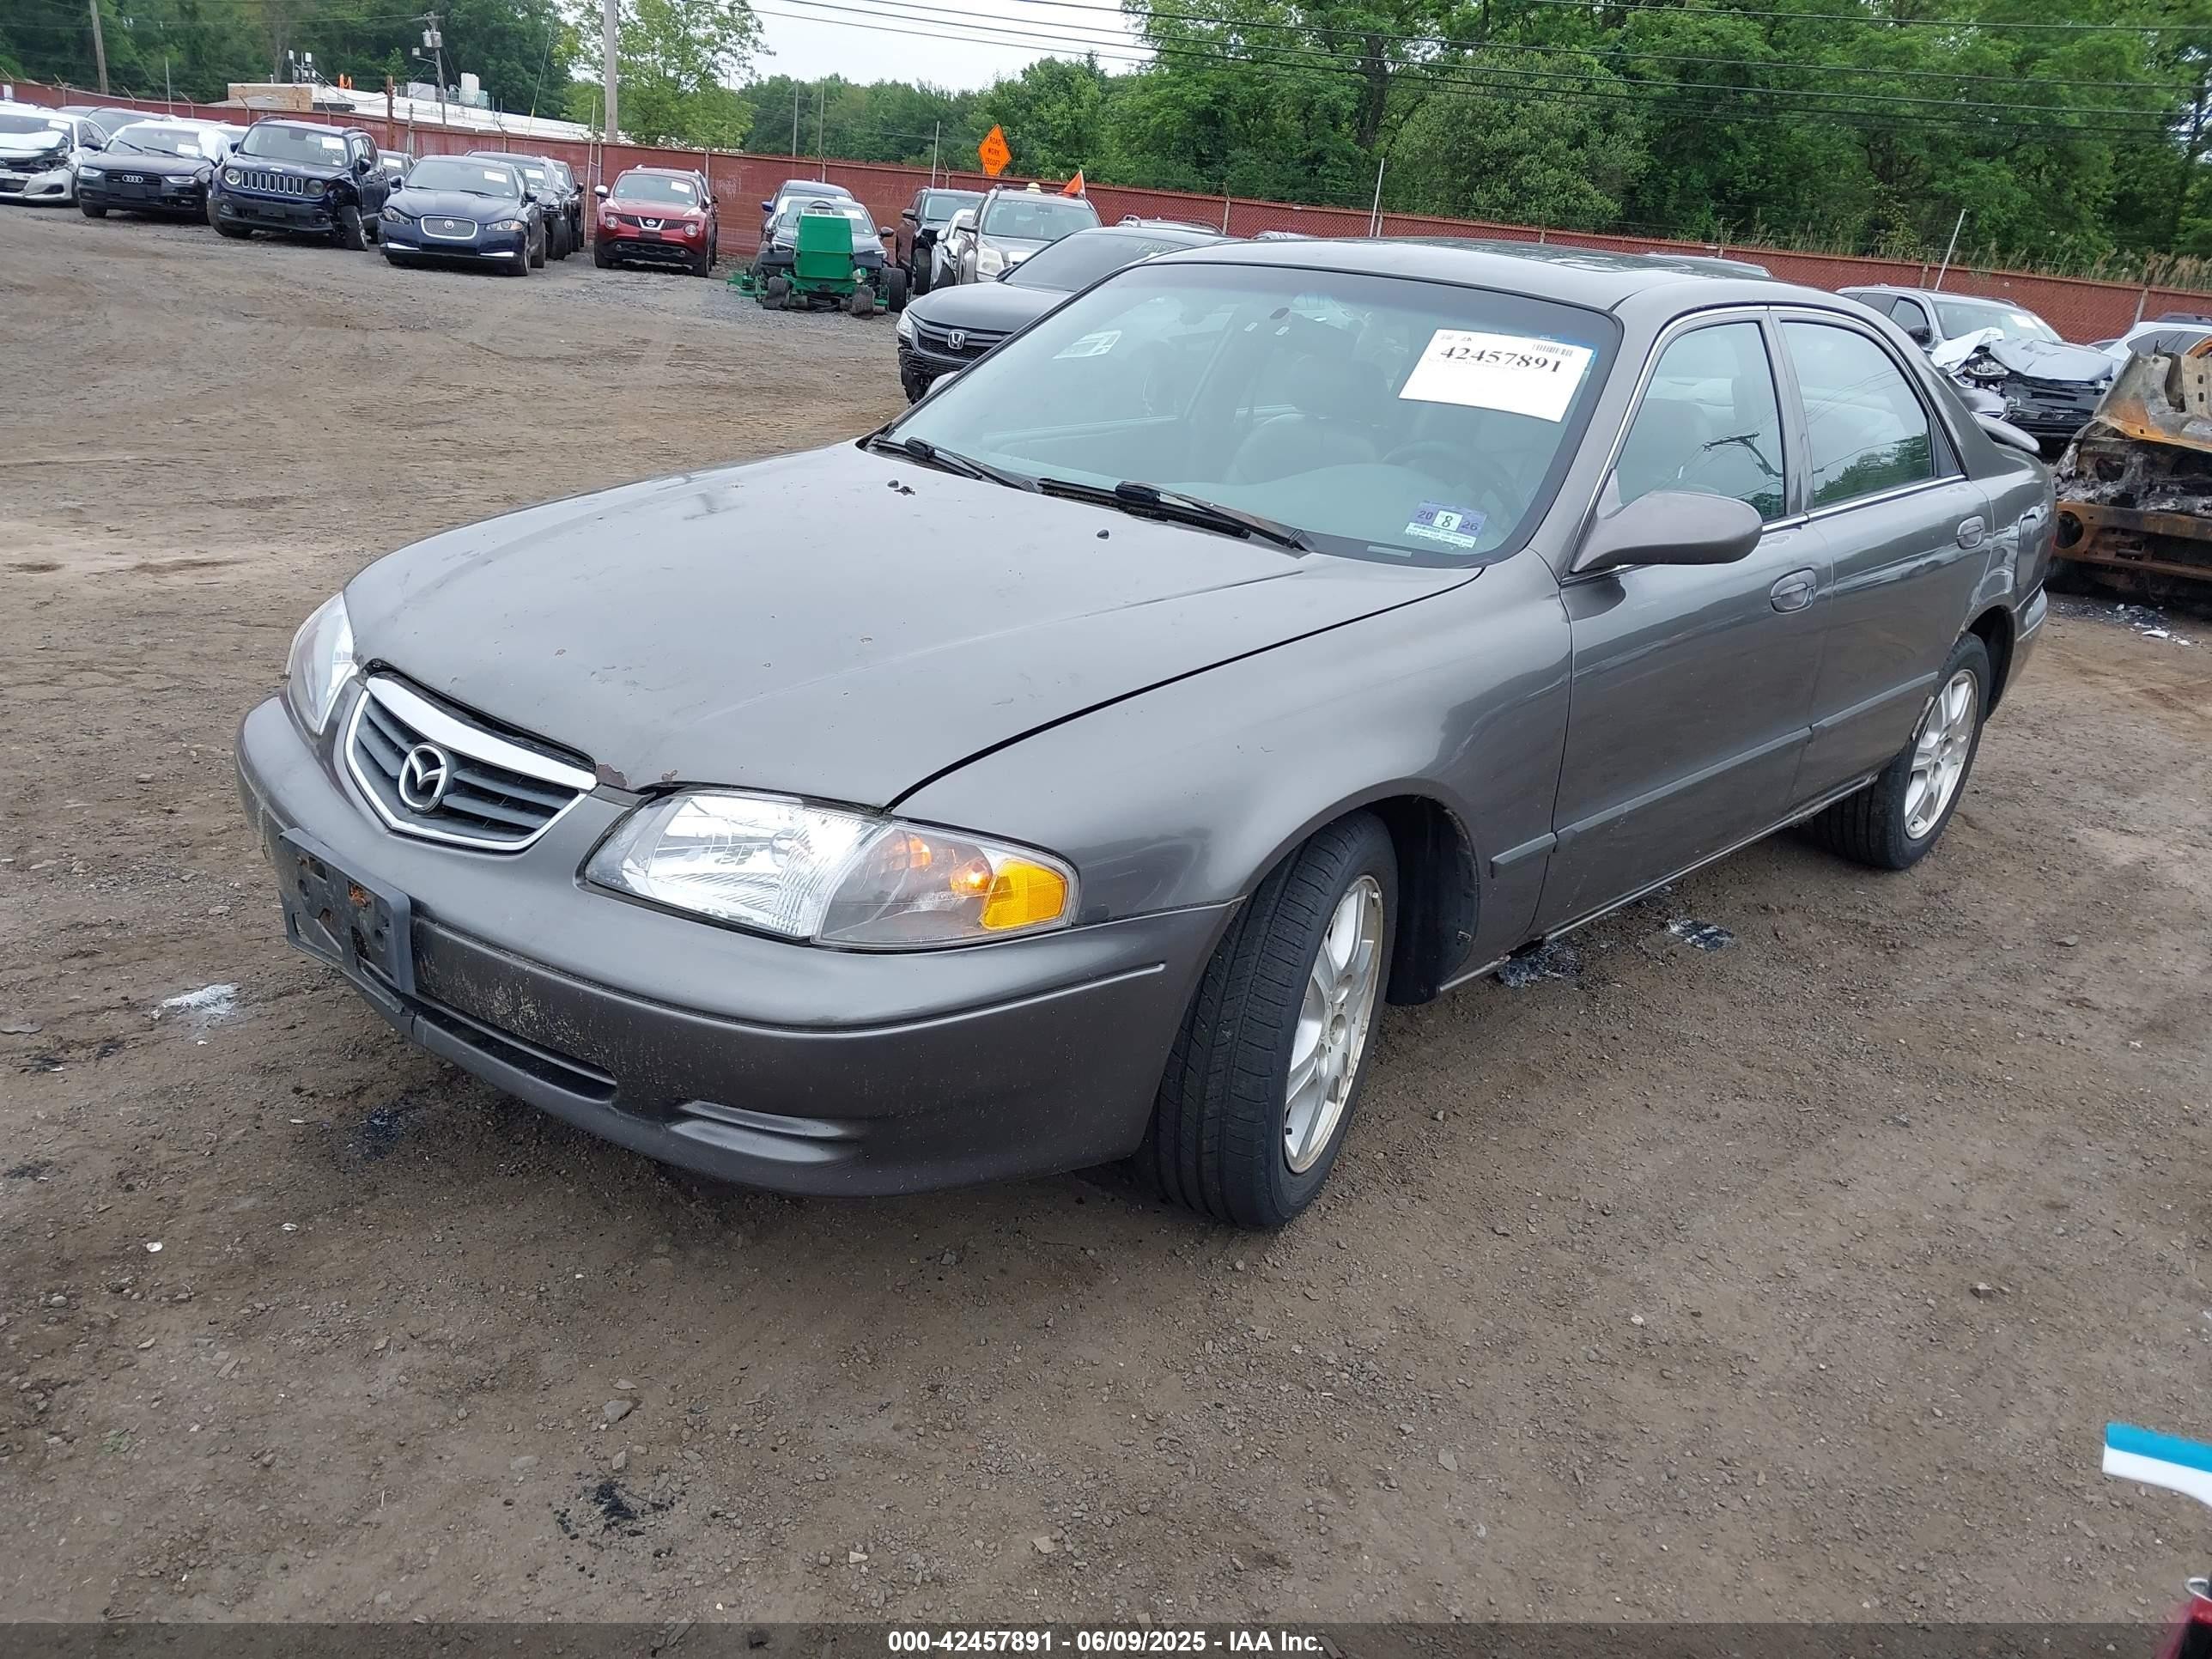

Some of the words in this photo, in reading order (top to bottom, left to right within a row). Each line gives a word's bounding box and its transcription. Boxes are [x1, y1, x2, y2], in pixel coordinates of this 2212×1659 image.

[989, 137, 1001, 146] ROAD
[988, 148, 1000, 156] WORK
[1440, 346, 1561, 373] 42457891
[1417, 510, 1434, 520] 20
[1441, 514, 1453, 528] 8
[1461, 520, 1479, 531] 26
